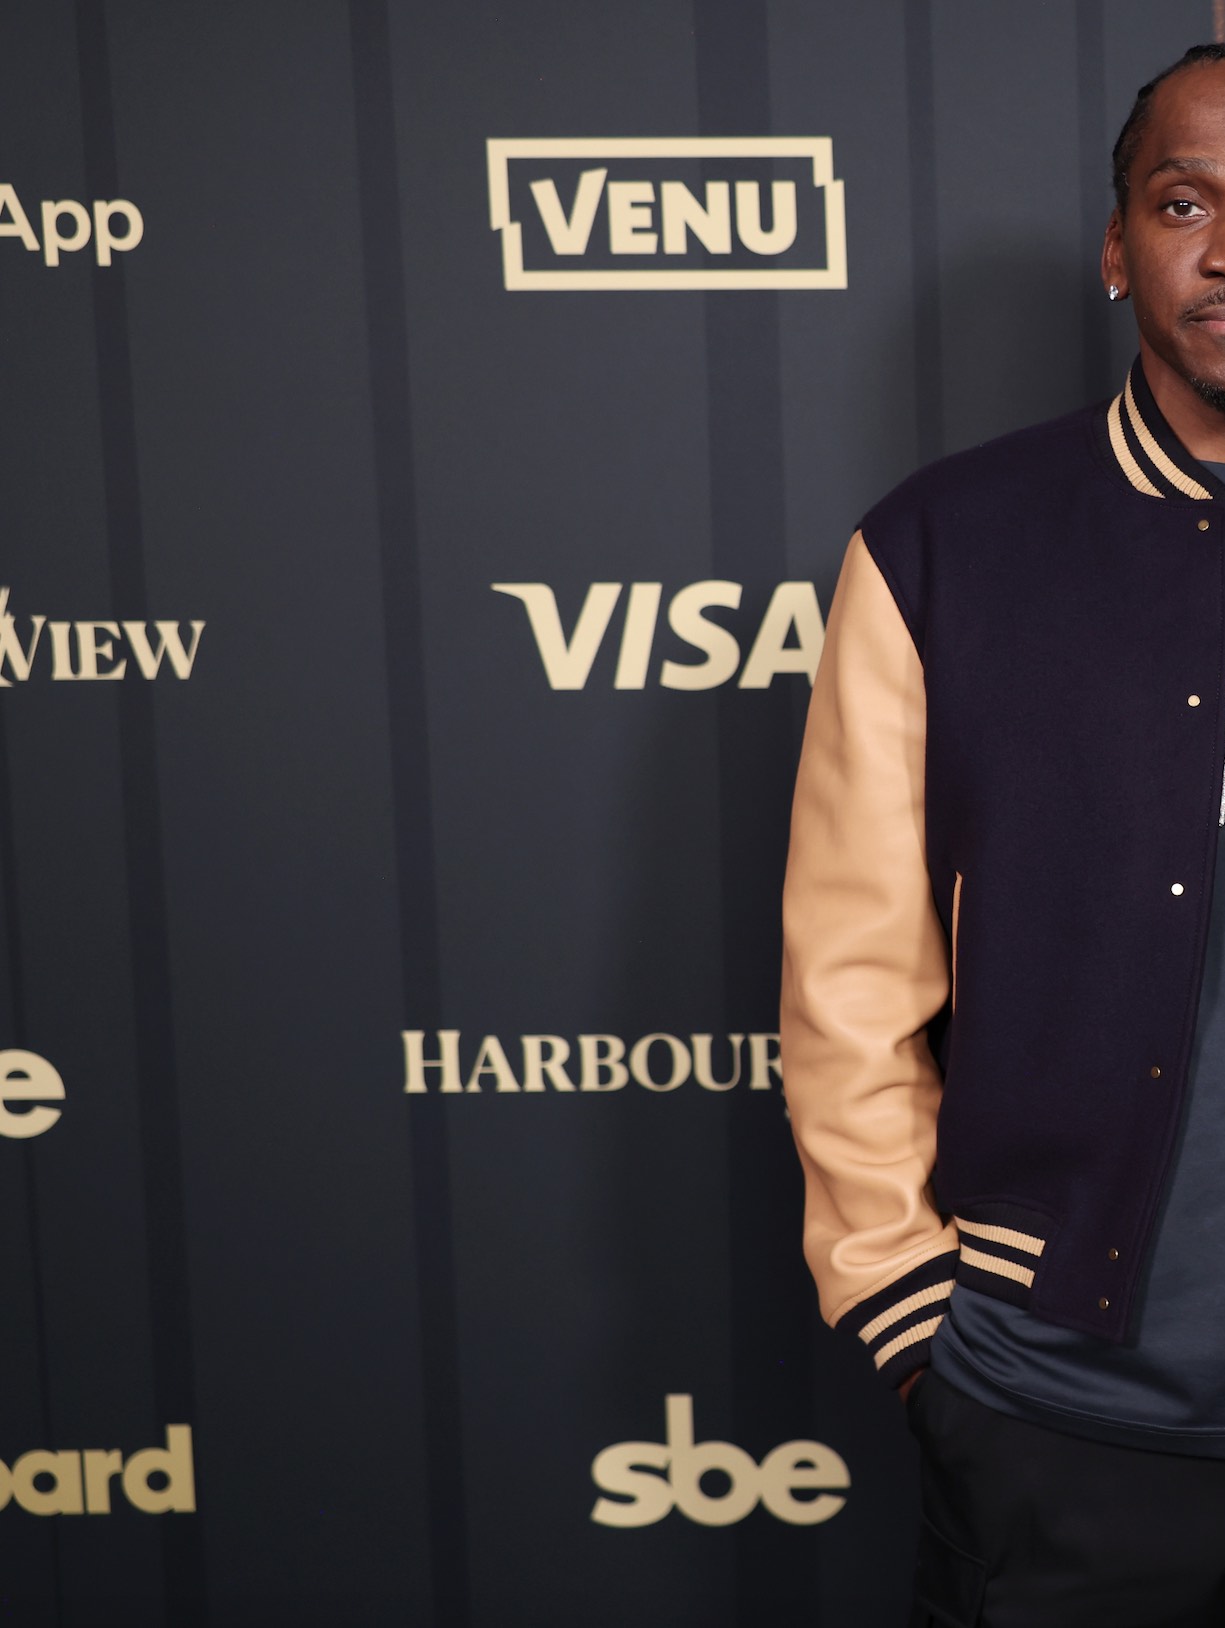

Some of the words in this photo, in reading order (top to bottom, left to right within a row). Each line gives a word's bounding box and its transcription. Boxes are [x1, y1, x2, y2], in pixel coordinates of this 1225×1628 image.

[530, 168, 798, 255] VENU
[491, 580, 827, 691] VISA
[0, 1423, 196, 1516] ard
[591, 1393, 850, 1528] sbe
